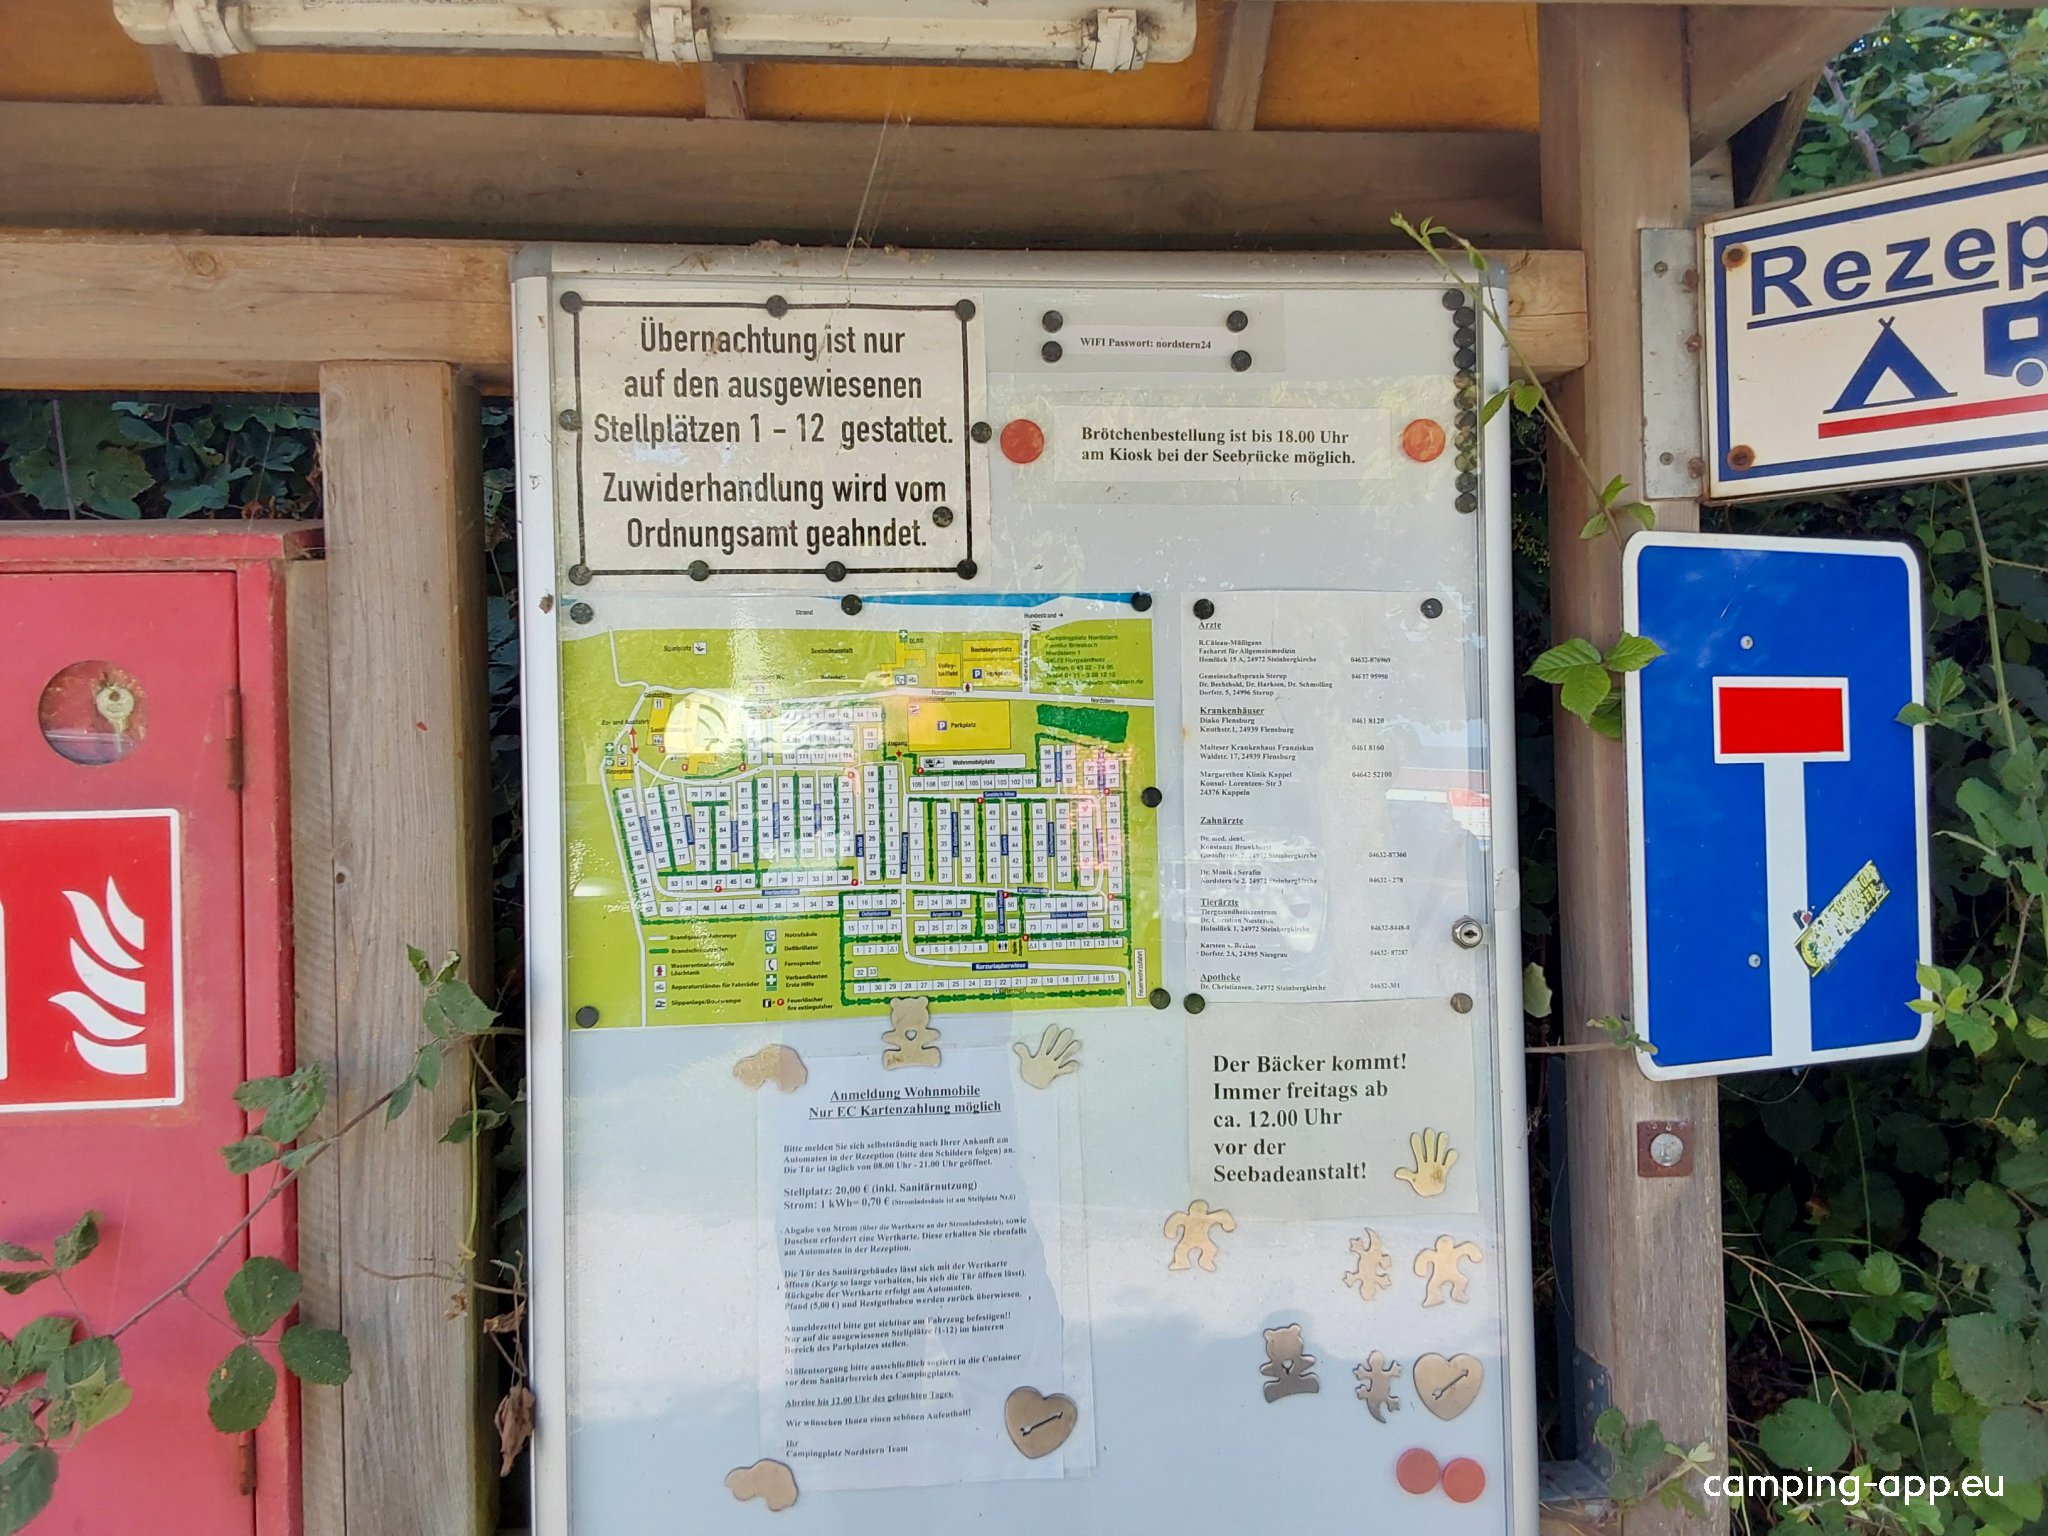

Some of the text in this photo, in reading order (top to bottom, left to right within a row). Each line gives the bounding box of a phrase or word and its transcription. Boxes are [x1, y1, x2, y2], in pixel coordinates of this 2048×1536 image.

[641, 317, 905, 360] Übernachtung ist nur
[1081, 337, 1211, 349] WIFI Passwort: nordstern24
[624, 369, 922, 405] auf den ausgewiesenen
[594, 414, 740, 449] Stellplätzen
[750, 414, 760, 442] 1
[797, 413, 824, 442] 12
[841, 416, 953, 449] gestattet.
[1082, 427, 1349, 445] Brötchenbestellung ist bis 18.00 Uhr
[1082, 448, 1356, 467] am Kiosk bei der Seebrücke möglich.
[603, 473, 946, 509] Zuwiderhandlung wird vom
[627, 518, 926, 555] Ordnungsamt geahndet.
[1200, 707, 1265, 715] Krankenhäuser
[1260, 726, 1294, 734] Flensburg
[1268, 771, 1292, 779] Kappel
[1200, 817, 1244, 825] Zahnärzte
[1200, 899, 1239, 907] Tierärzte
[976, 962, 1027, 970] Kurzurlauberwiese
[1200, 974, 1240, 982] Apotheke
[1213, 1053, 1406, 1072] Der Bäcker kommt!
[830, 1085, 980, 1102] Anmeldung Wohnmobile
[1213, 1080, 1388, 1101] Immer freitags ab
[809, 1101, 1001, 1120] Nur EC Kartenzahlung möglich
[1213, 1108, 1342, 1128] ca. 12.00 Uhr
[1214, 1139, 1286, 1155] vor der
[784, 1166, 796, 1174] Die
[829, 1164, 854, 1174] täglich
[896, 1161, 911, 1169] Uhr
[919, 1160, 940, 1168] 21.00
[943, 1159, 957, 1168] Uhr
[959, 1158, 992, 1168] geöffnet.
[1213, 1162, 1366, 1182] Seebadeanstalt!
[784, 1181, 977, 1199] Stellplatz: 20,00 € (inkl. Sanitärnutzung)
[784, 1201, 817, 1210] Strom:
[821, 1200, 825, 1208] 1
[862, 1197, 881, 1207] 0,70
[884, 1197, 890, 1206] €
[786, 1409, 971, 1428] Wir wünschen Ihnen einen schönen Aufenthalt!
[786, 1445, 908, 1459] Campingplatz Nordstern Team
